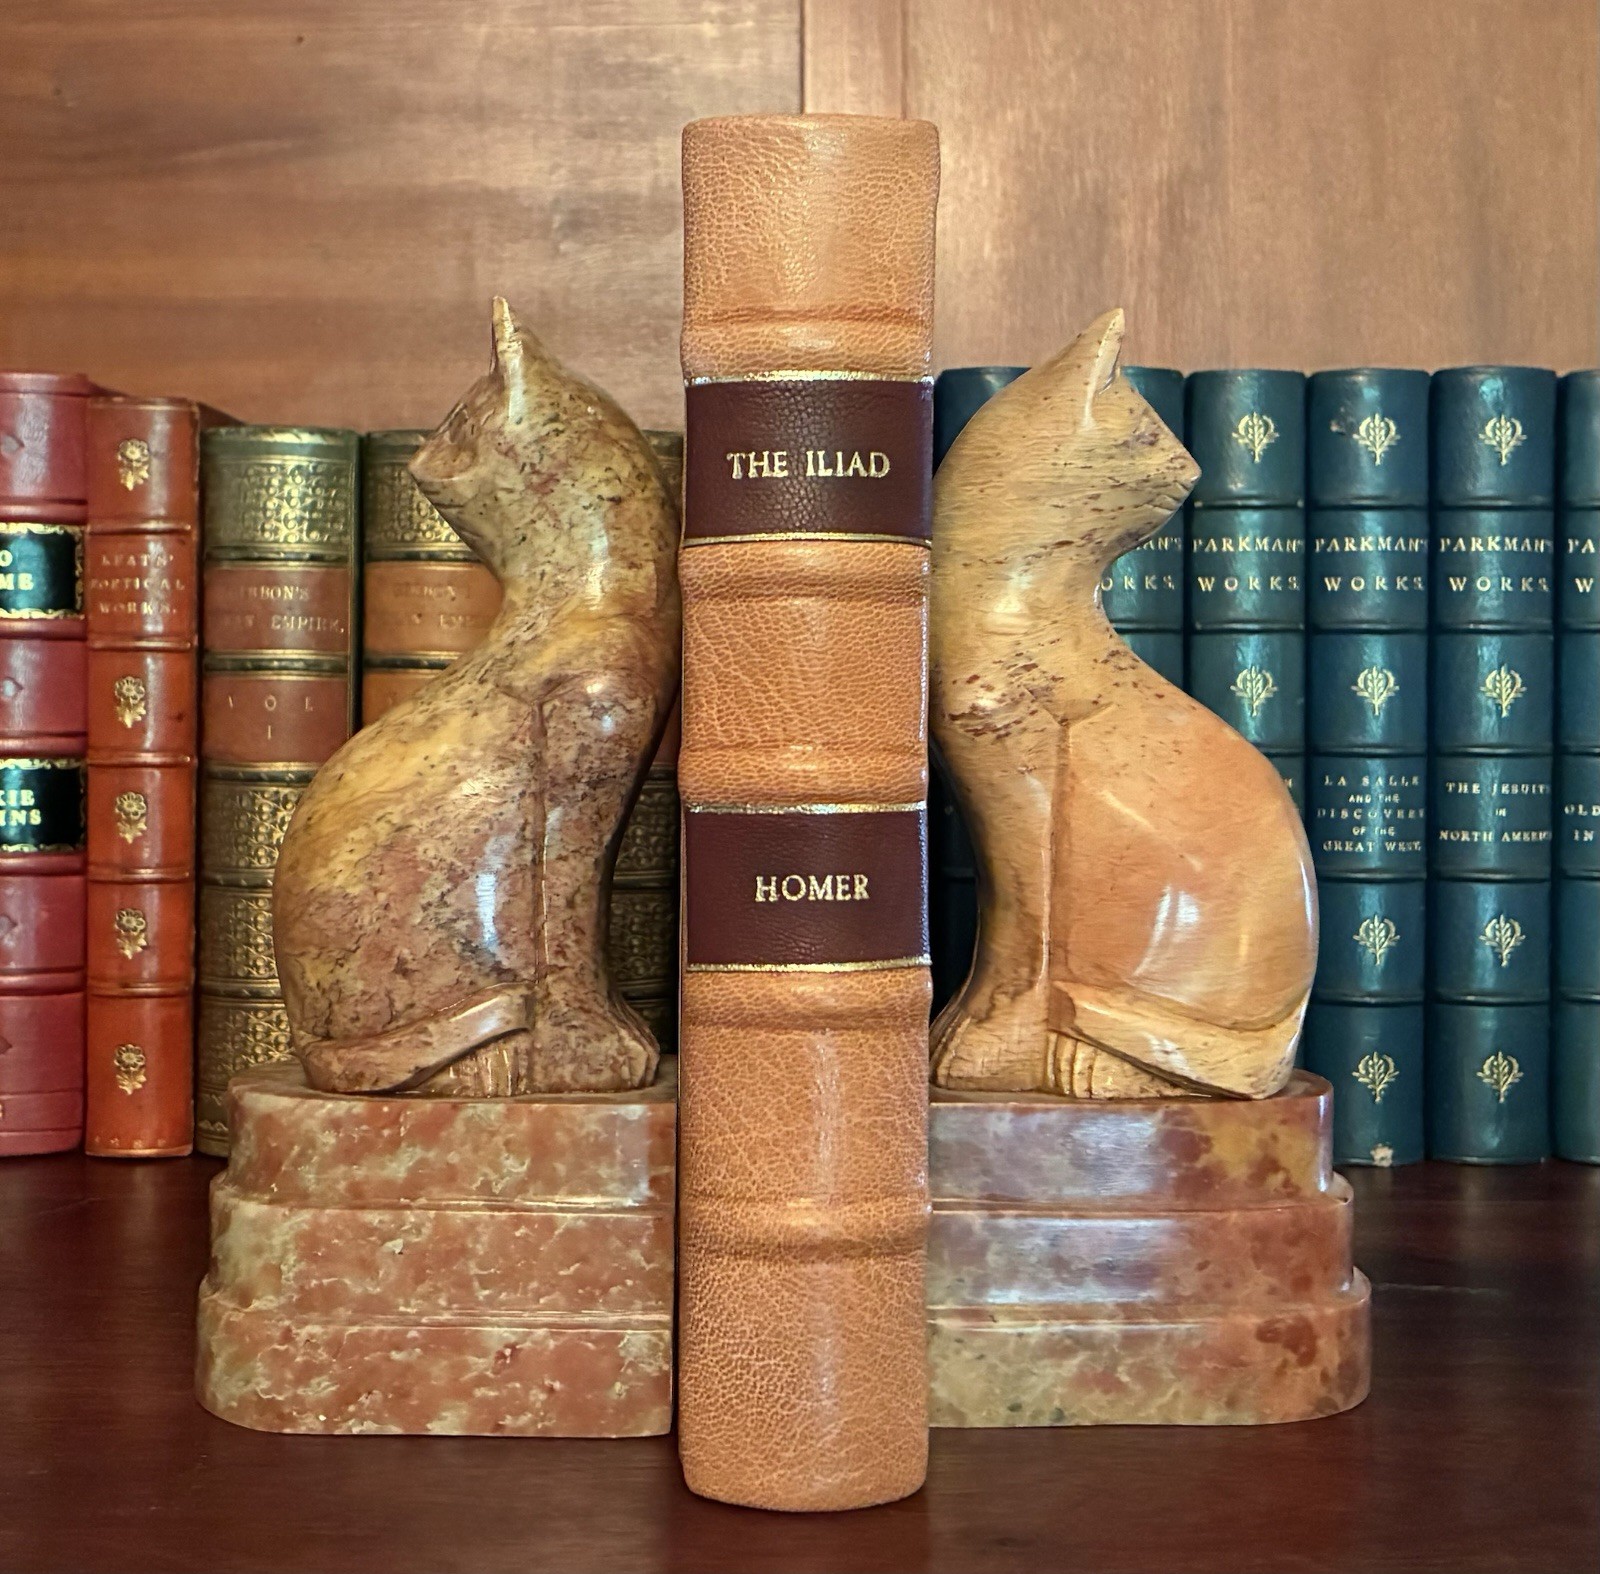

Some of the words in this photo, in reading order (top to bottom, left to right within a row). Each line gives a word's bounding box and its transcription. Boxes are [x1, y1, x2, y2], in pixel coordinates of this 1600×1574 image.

[727, 451, 789, 479] THE
[806, 450, 890, 478] ILIAD
[1136, 537, 1182, 550] AN'S
[1193, 536, 1304, 553] PARKMAN'
[1440, 536, 1553, 553] PARKMAN'
[1100, 575, 1175, 592] ORKS
[1446, 782, 1480, 794] THE
[1348, 794, 1372, 803] AND
[1352, 826, 1367, 836] OF
[1439, 830, 1492, 842] NORTH
[1323, 840, 1376, 852] GREAT
[755, 875, 870, 902] HOMER
